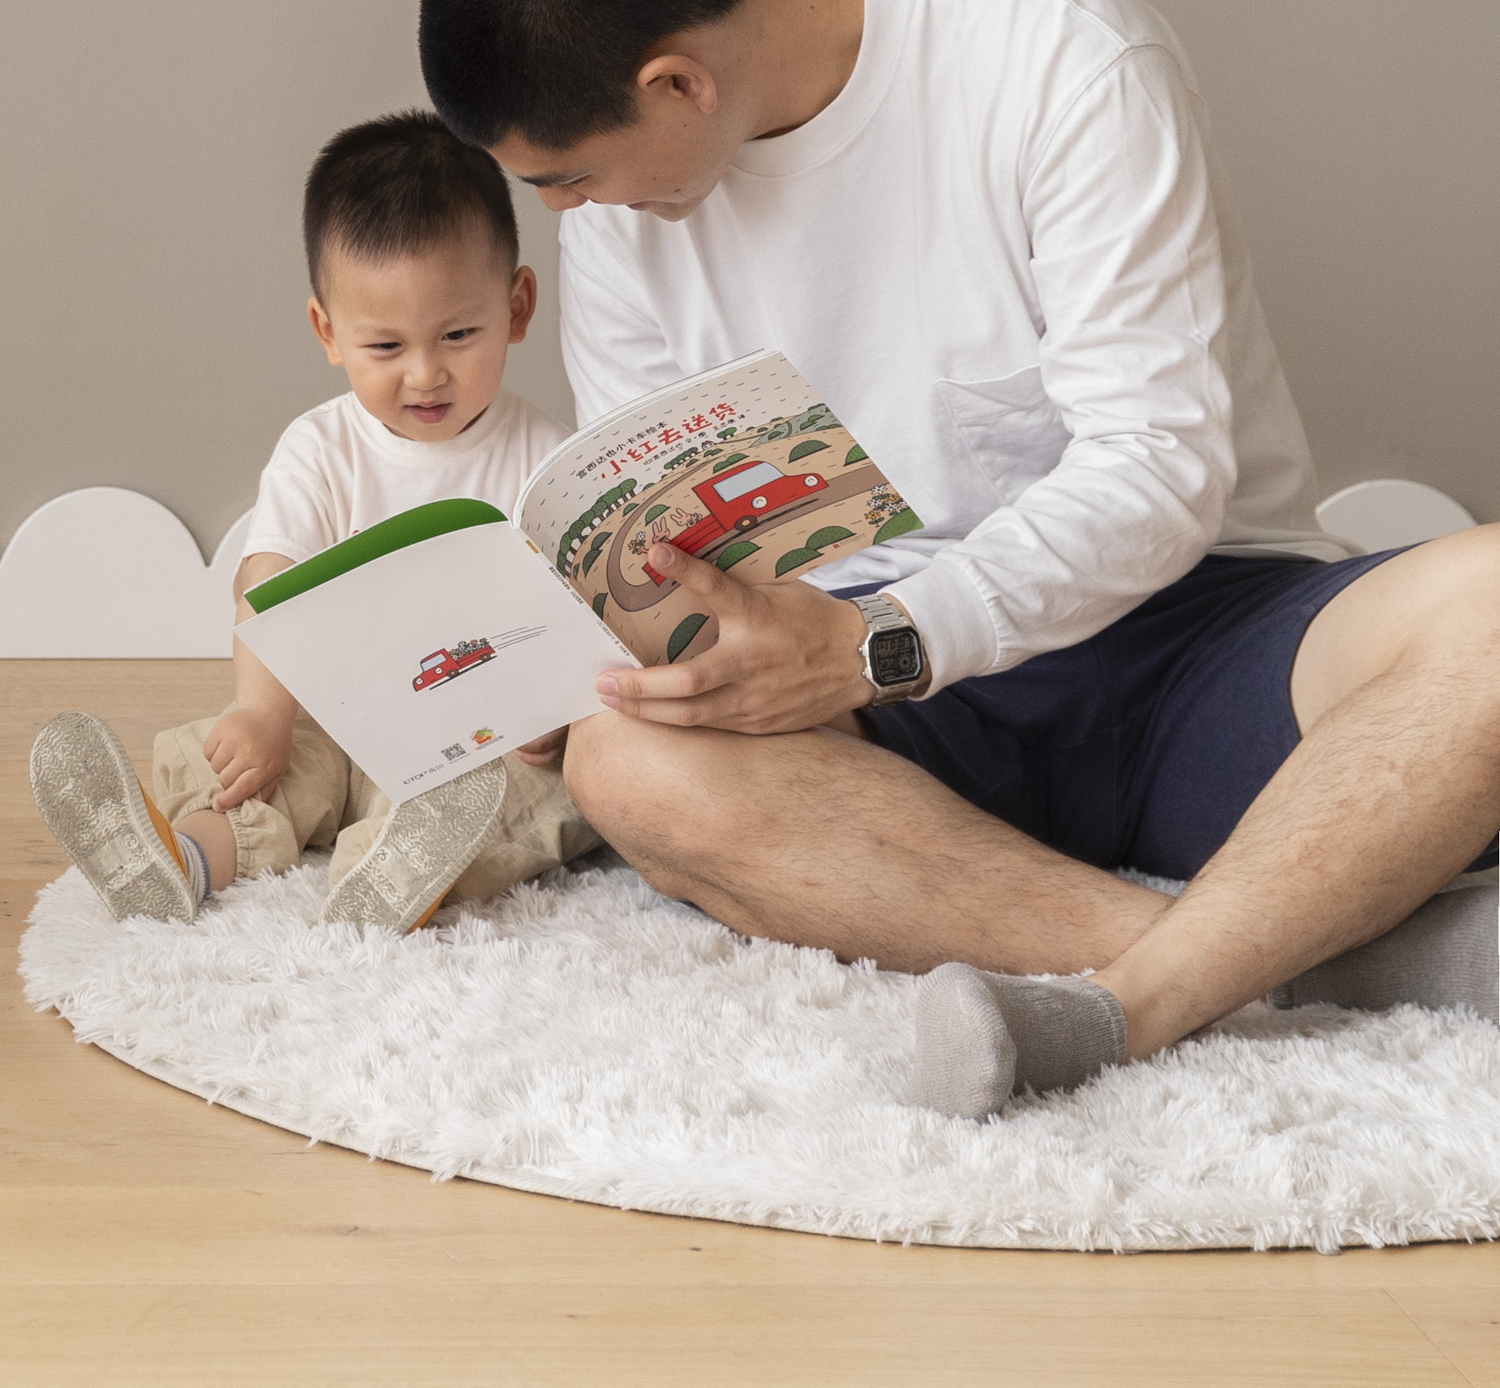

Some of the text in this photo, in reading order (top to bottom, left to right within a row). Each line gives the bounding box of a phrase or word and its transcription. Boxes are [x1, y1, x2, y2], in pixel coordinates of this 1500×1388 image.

[601, 403, 736, 479] 小红去送货
